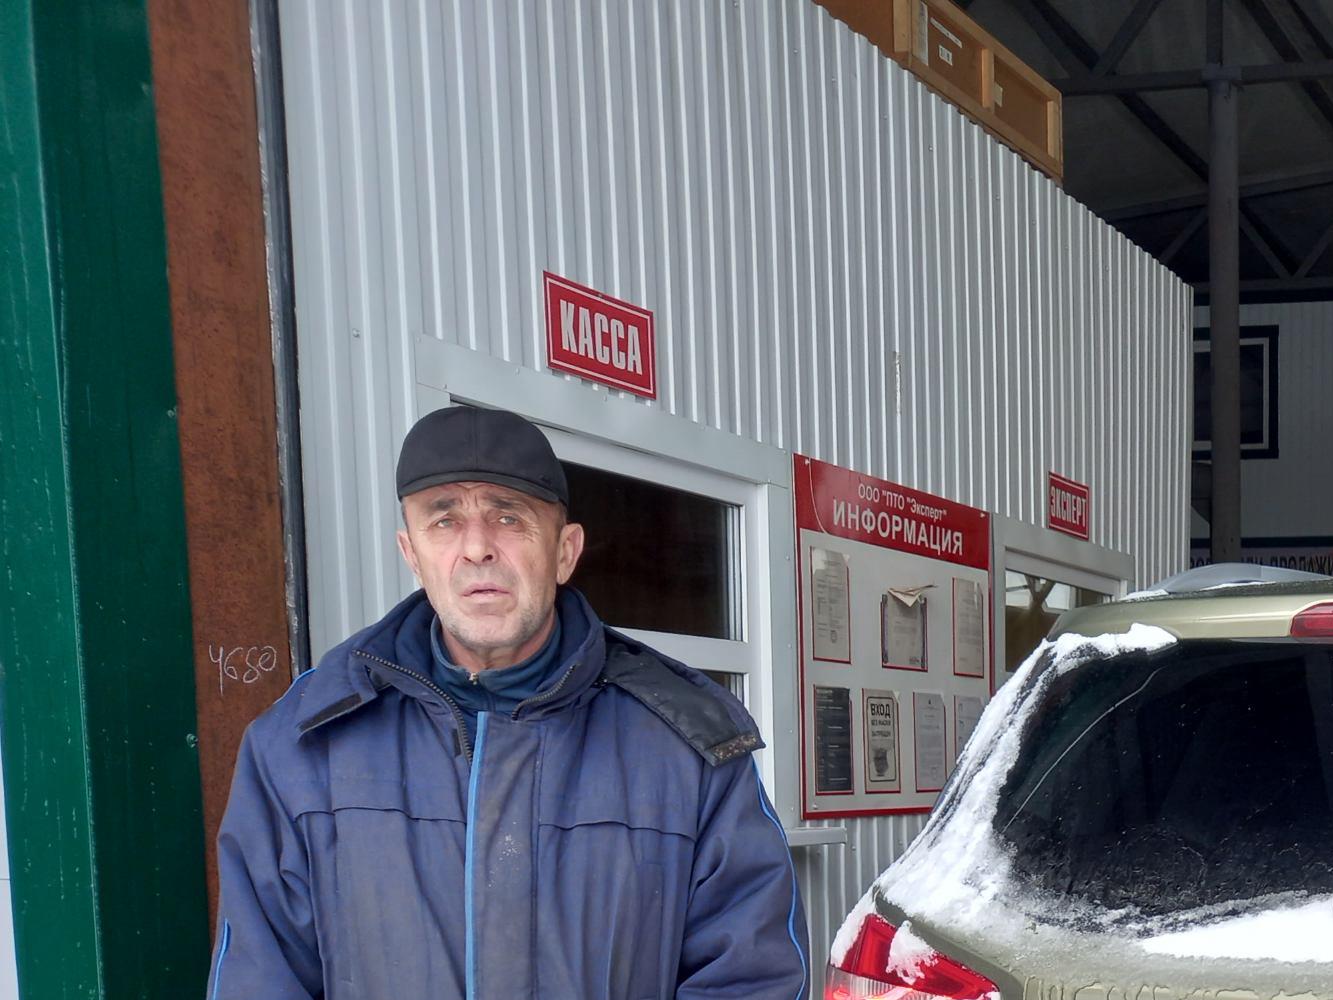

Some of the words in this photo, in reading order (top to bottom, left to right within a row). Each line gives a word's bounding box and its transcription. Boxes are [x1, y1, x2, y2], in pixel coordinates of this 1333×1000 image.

[560, 298, 643, 376] КАССА
[858, 483, 880, 503] ООО
[1050, 485, 1087, 528] ЭКСПЕРТ
[833, 499, 963, 556] ИНФОРМАЦИЯ
[870, 703, 891, 719] ВХОД
